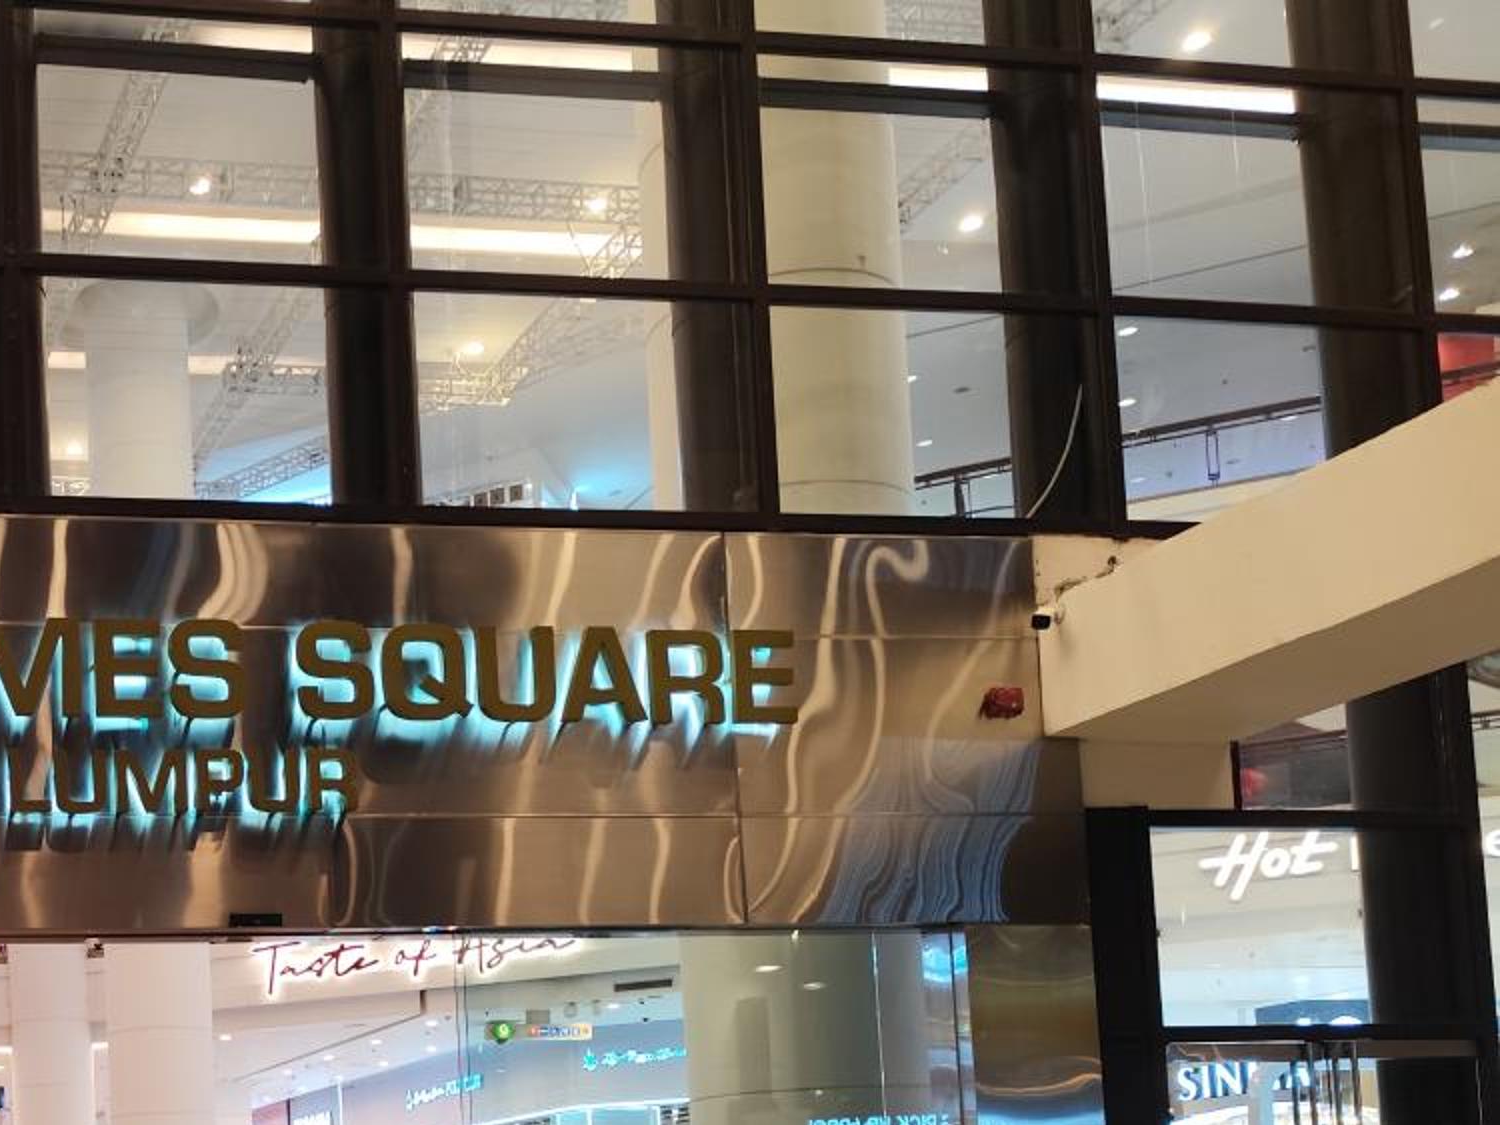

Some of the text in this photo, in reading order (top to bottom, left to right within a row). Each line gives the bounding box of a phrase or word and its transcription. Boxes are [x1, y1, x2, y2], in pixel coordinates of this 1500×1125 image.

[296, 619, 799, 729] SQUARE
[5, 748, 360, 815] LUMPUR
[1199, 830, 1339, 901] Hot
[253, 941, 378, 996] Taste
[395, 938, 437, 976] of
